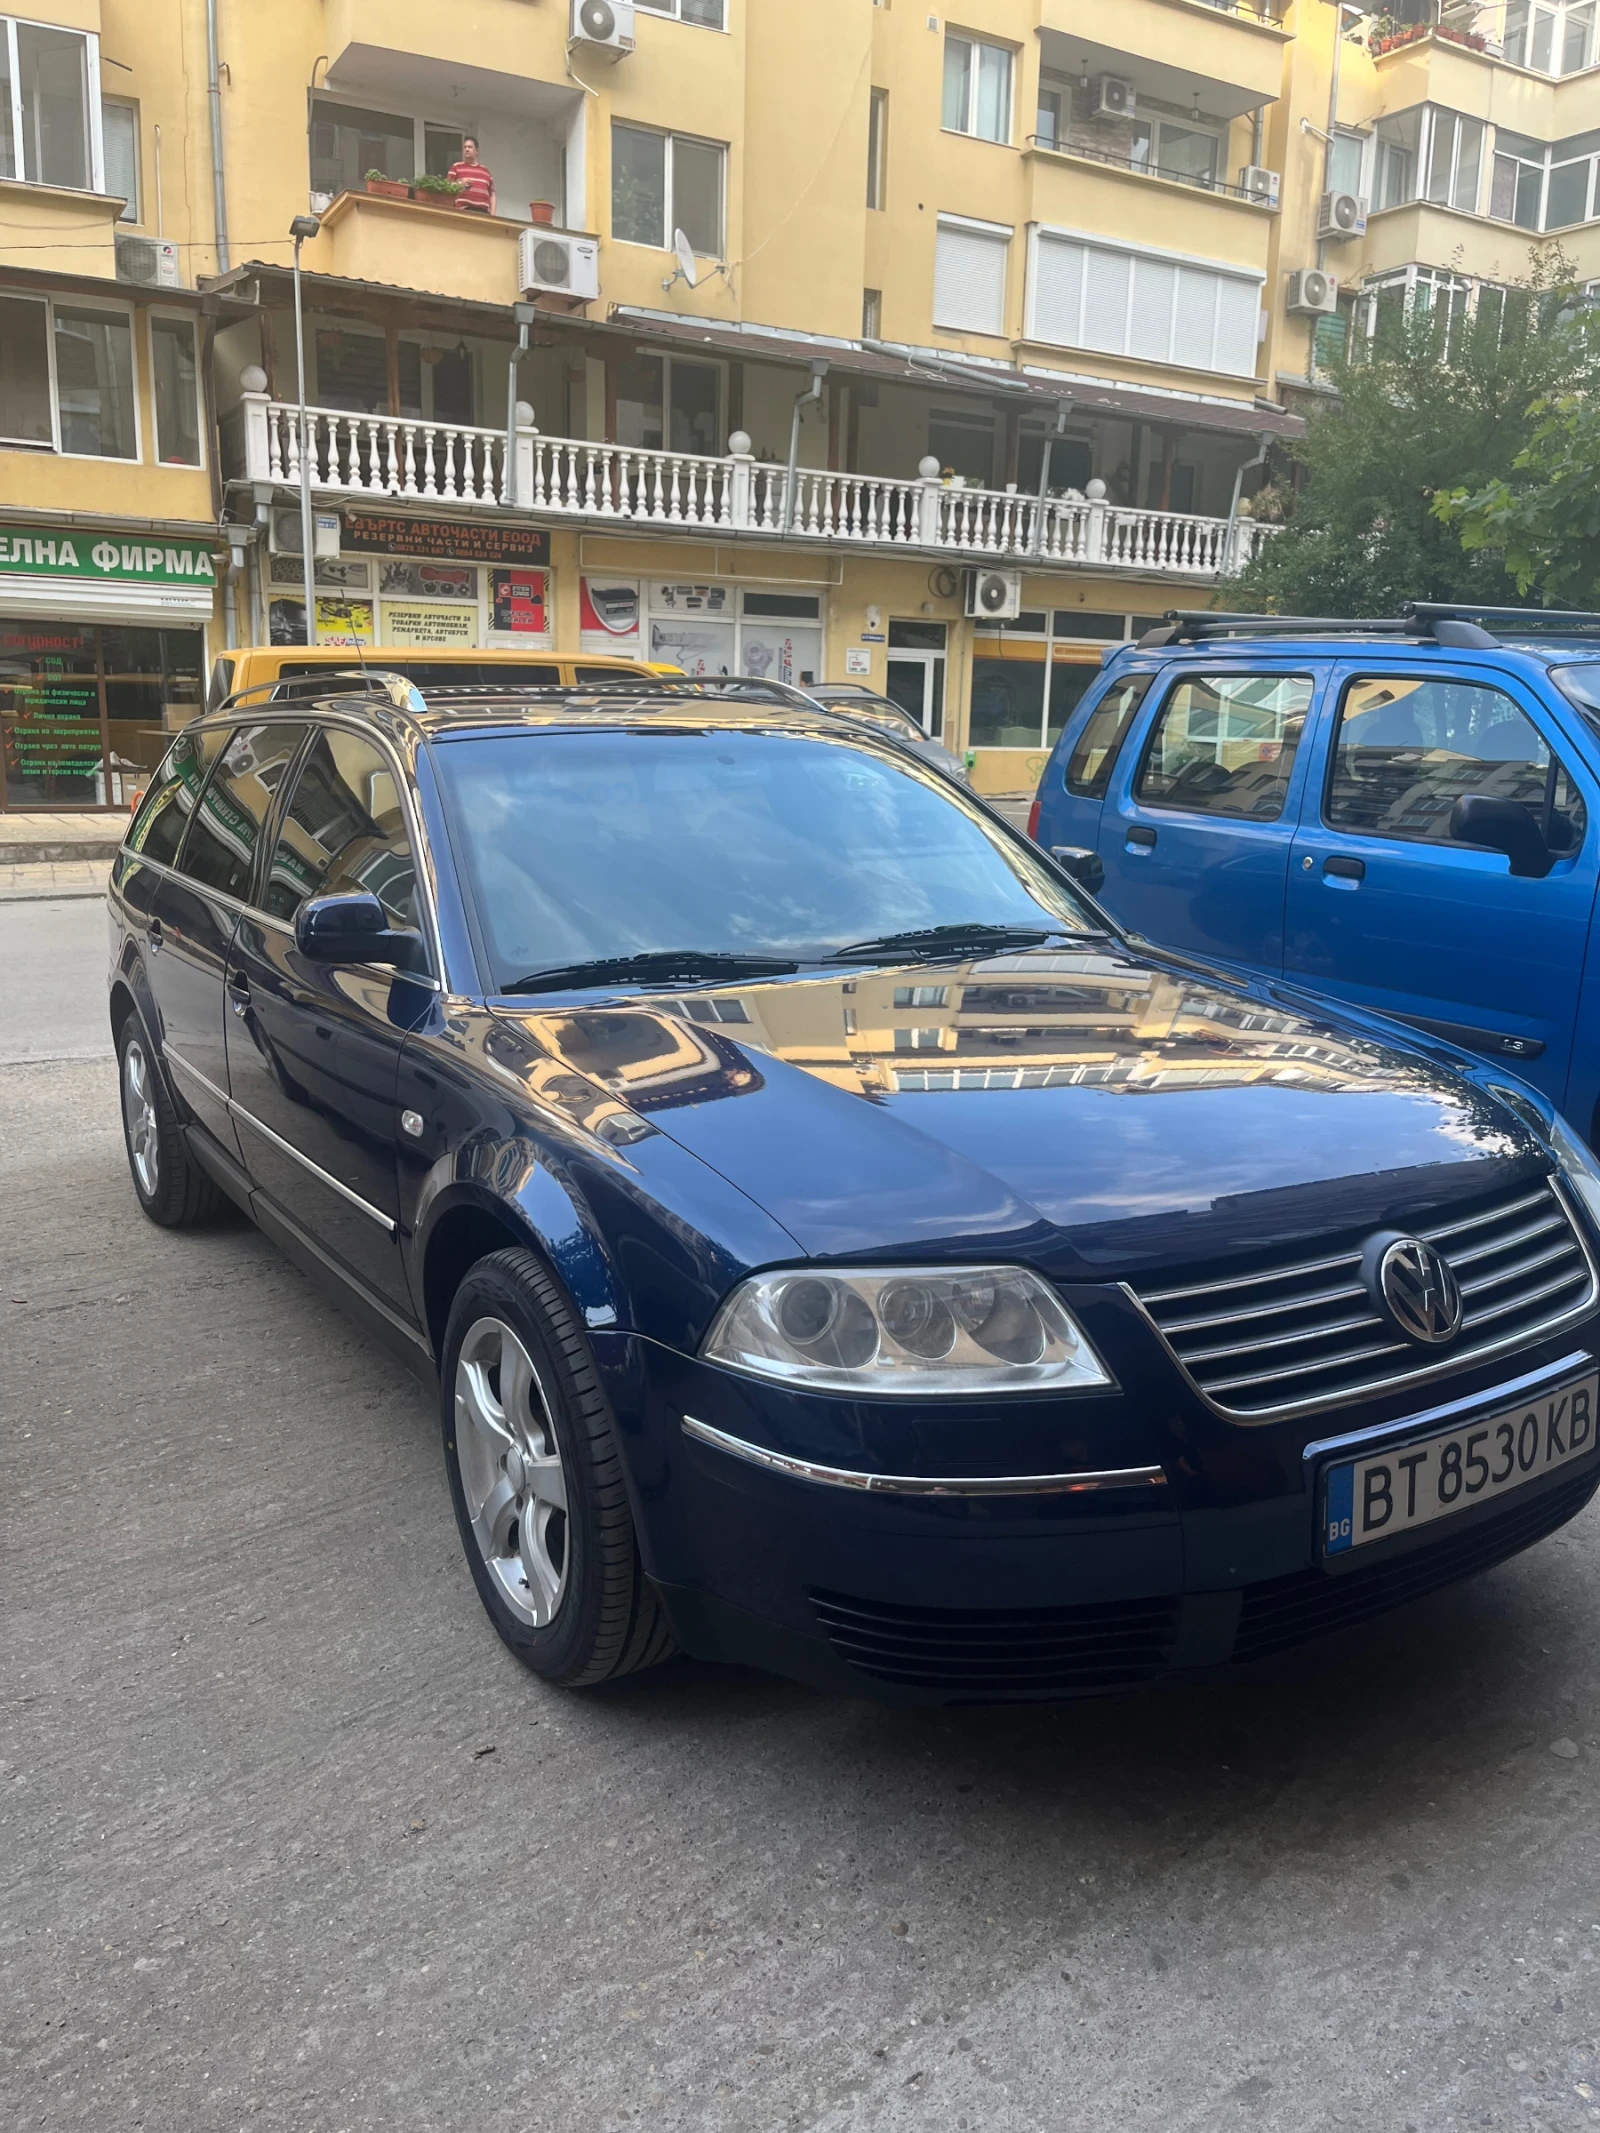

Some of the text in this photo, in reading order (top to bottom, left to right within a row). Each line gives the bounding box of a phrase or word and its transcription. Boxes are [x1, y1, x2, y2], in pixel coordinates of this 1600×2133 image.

[353, 530, 533, 553] РЕЗЕРВНИ ЧАСТИ И СЕРВИЗ
[411, 522, 498, 541] АВТОЧАСТИ
[502, 530, 541, 547] ЕООД
[0, 537, 214, 577] ЕЛНА ФИРМА
[14, 727, 40, 735] Охрана
[14, 742, 40, 750] Охрана
[20, 759, 46, 767] Охрана
[1362, 1388, 1591, 1532] BT 8530 KB
[1329, 1518, 1351, 1542] BG
